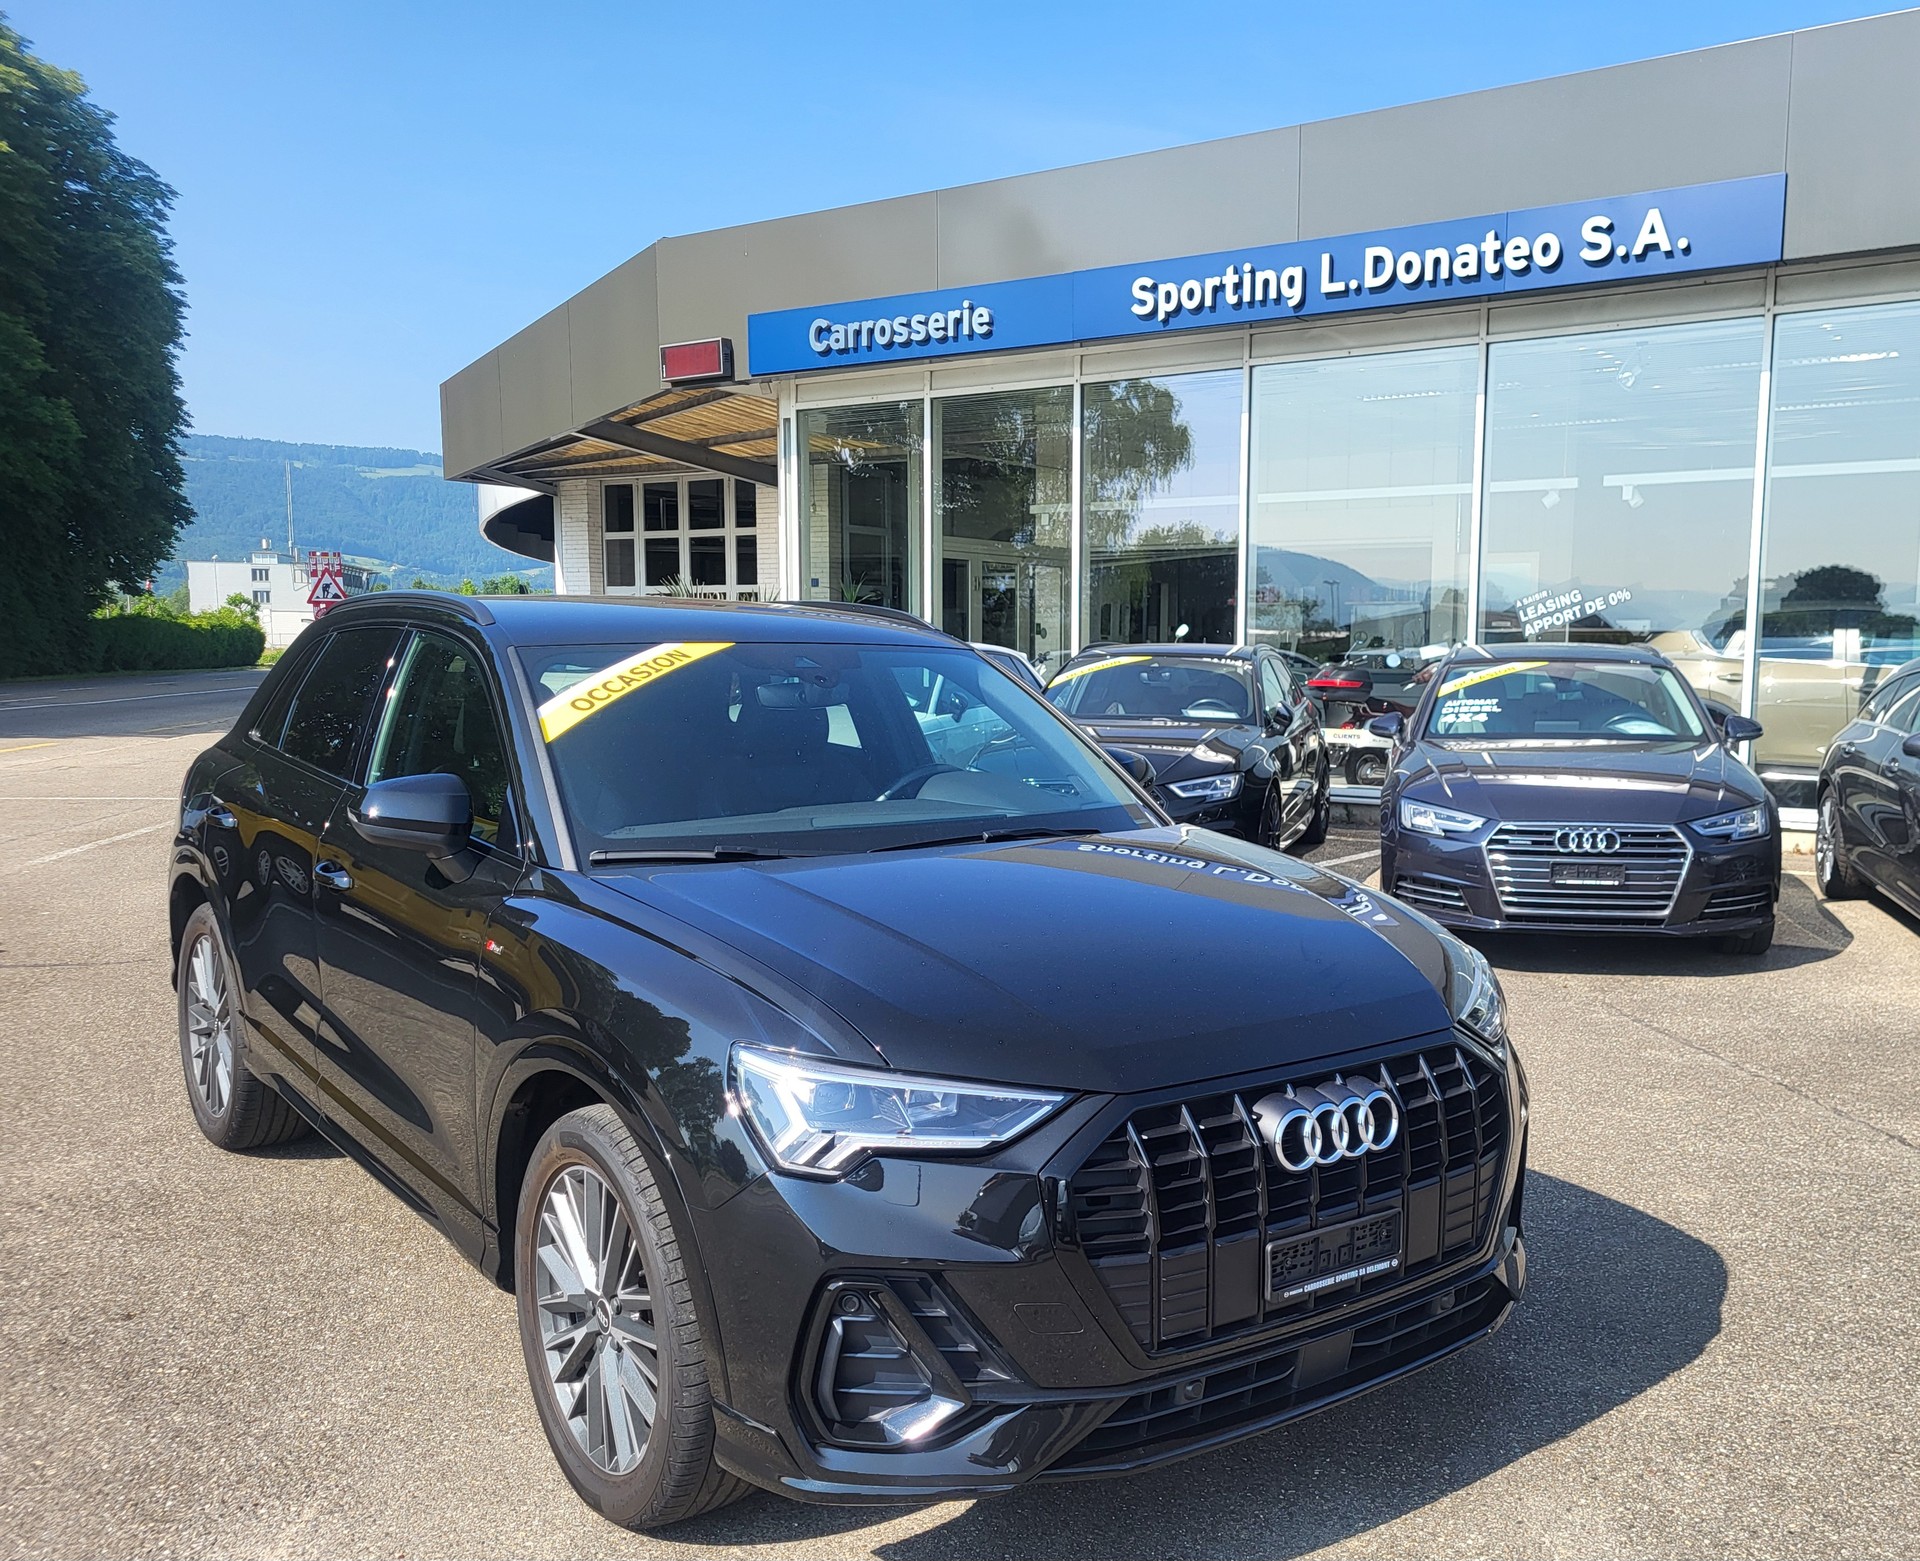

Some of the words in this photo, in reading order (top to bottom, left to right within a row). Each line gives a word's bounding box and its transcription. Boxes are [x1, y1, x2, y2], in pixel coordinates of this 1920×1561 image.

[1132, 263, 1303, 320] Sporting
[1321, 230, 1560, 292] L.Donateo
[1580, 209, 1688, 260] S.A.
[809, 300, 992, 353] Carrosserie
[1519, 589, 1583, 622] LEASING
[1522, 590, 1548, 606] SAISIR
[1524, 604, 1582, 637] APPORT
[1584, 596, 1607, 615] DE
[1608, 588, 1632, 606] 0%
[570, 649, 692, 711] OCCASION
[1441, 705, 1502, 715] DIESEL
[1444, 698, 1499, 707] AUTOMAT
[1304, 1276, 1335, 1292] CARROSSERIE
[1335, 1270, 1358, 1283] SPORTING
